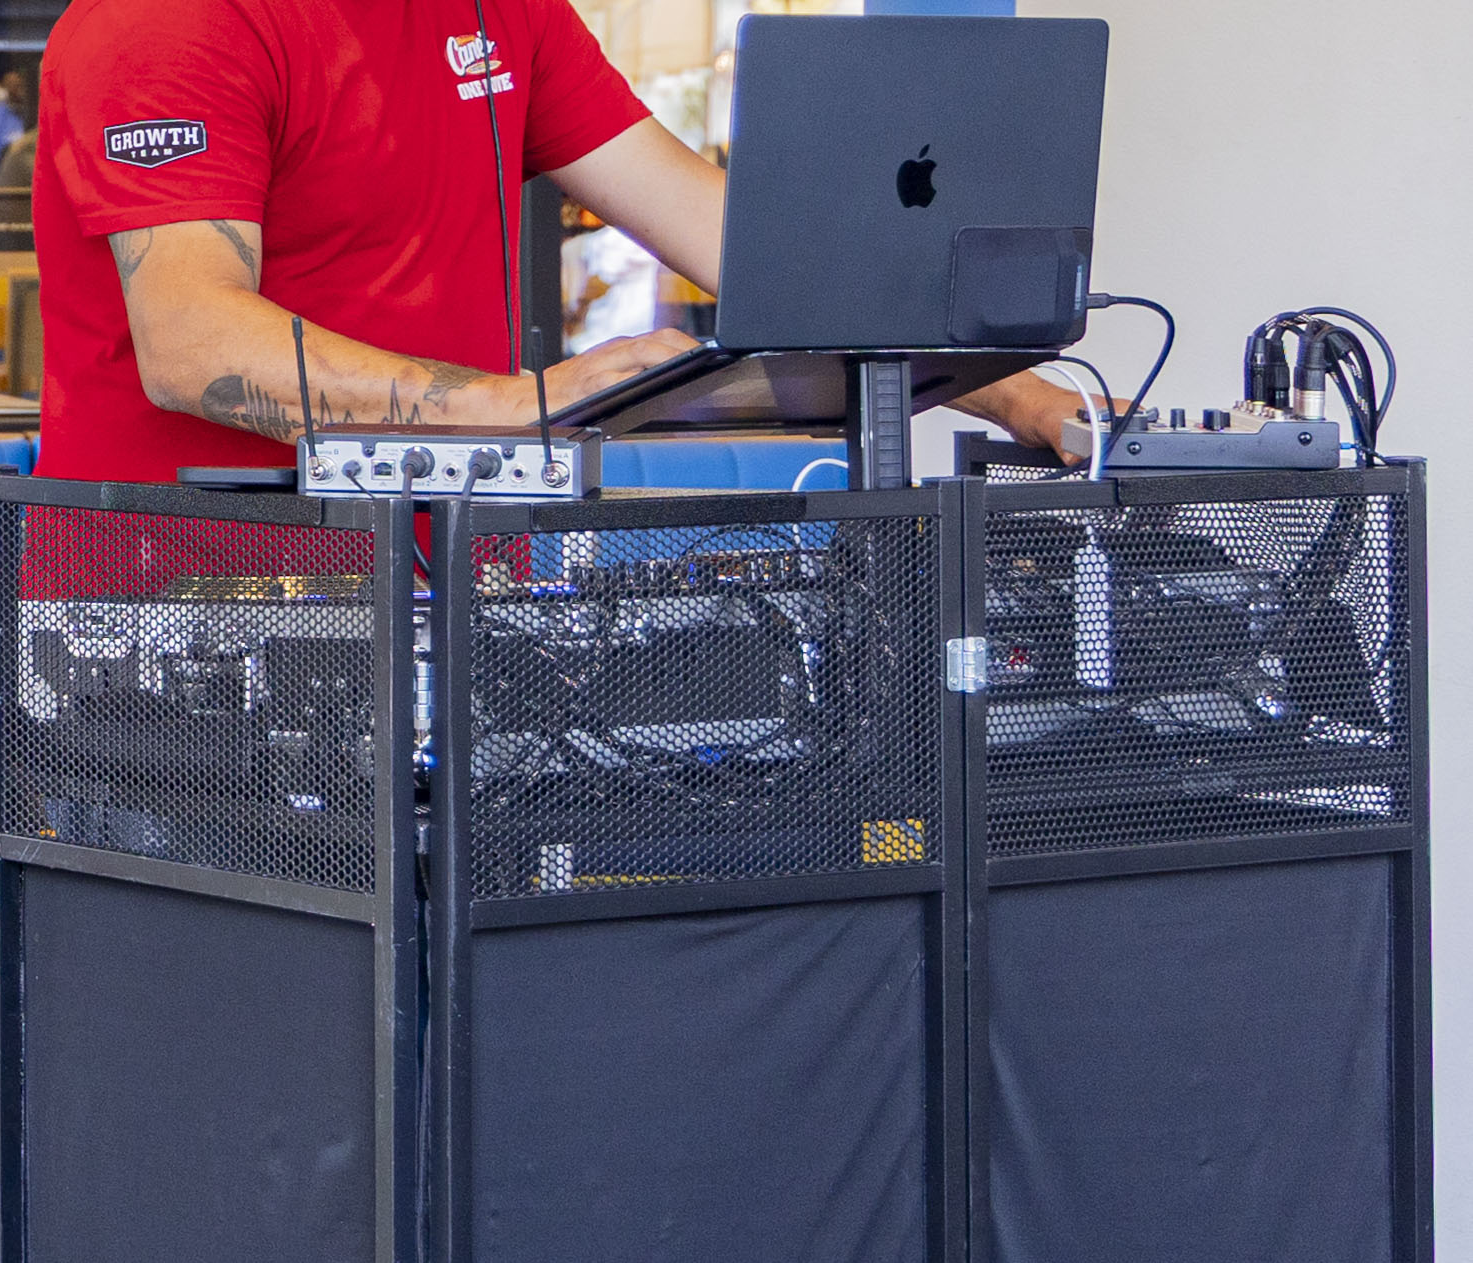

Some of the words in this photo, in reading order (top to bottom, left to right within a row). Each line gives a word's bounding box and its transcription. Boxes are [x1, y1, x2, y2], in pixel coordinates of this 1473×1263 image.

[457, 80, 486, 100] ONE
[110, 127, 199, 152] GROWTH
[131, 148, 173, 158] TEAM
